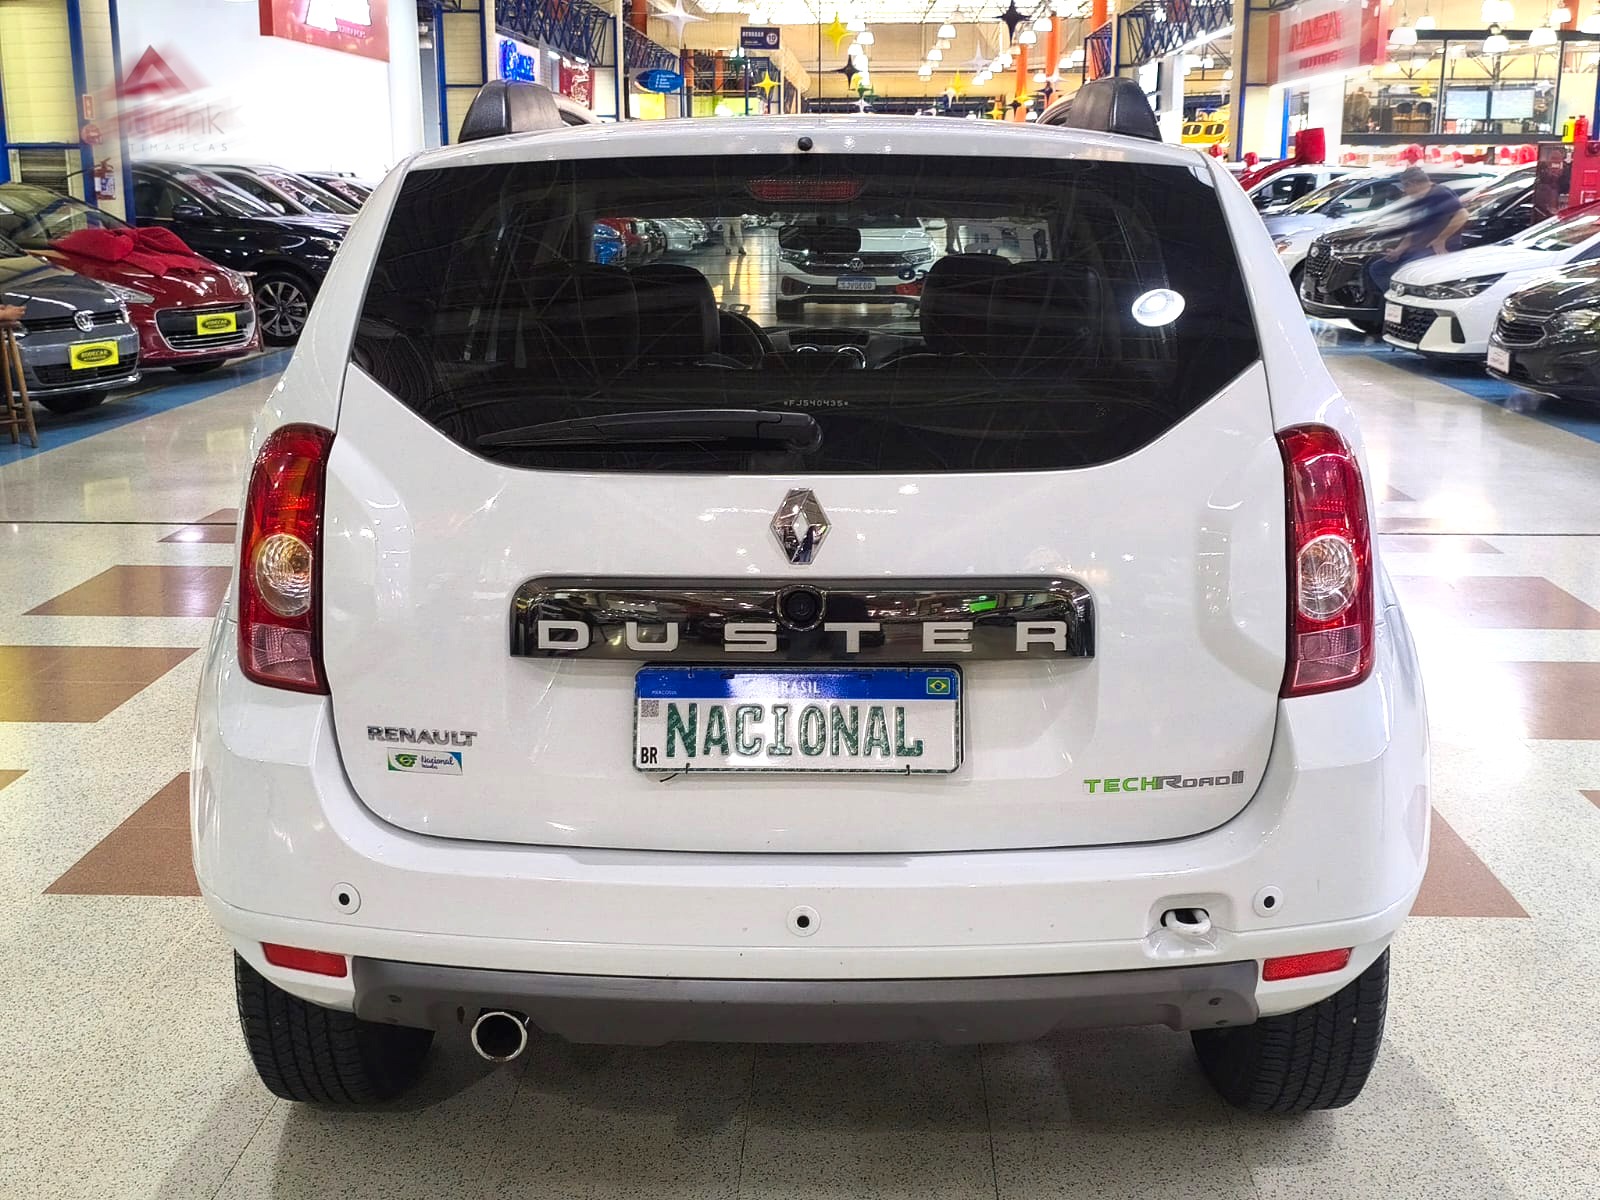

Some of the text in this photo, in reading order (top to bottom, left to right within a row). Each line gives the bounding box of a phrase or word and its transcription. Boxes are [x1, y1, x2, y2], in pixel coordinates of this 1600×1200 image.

[537, 620, 1068, 653] DUSTER
[367, 725, 478, 747] RENAULT
[665, 702, 924, 758] NACIONAL
[421, 754, 455, 766] Nacional
[640, 746, 658, 764] BR
